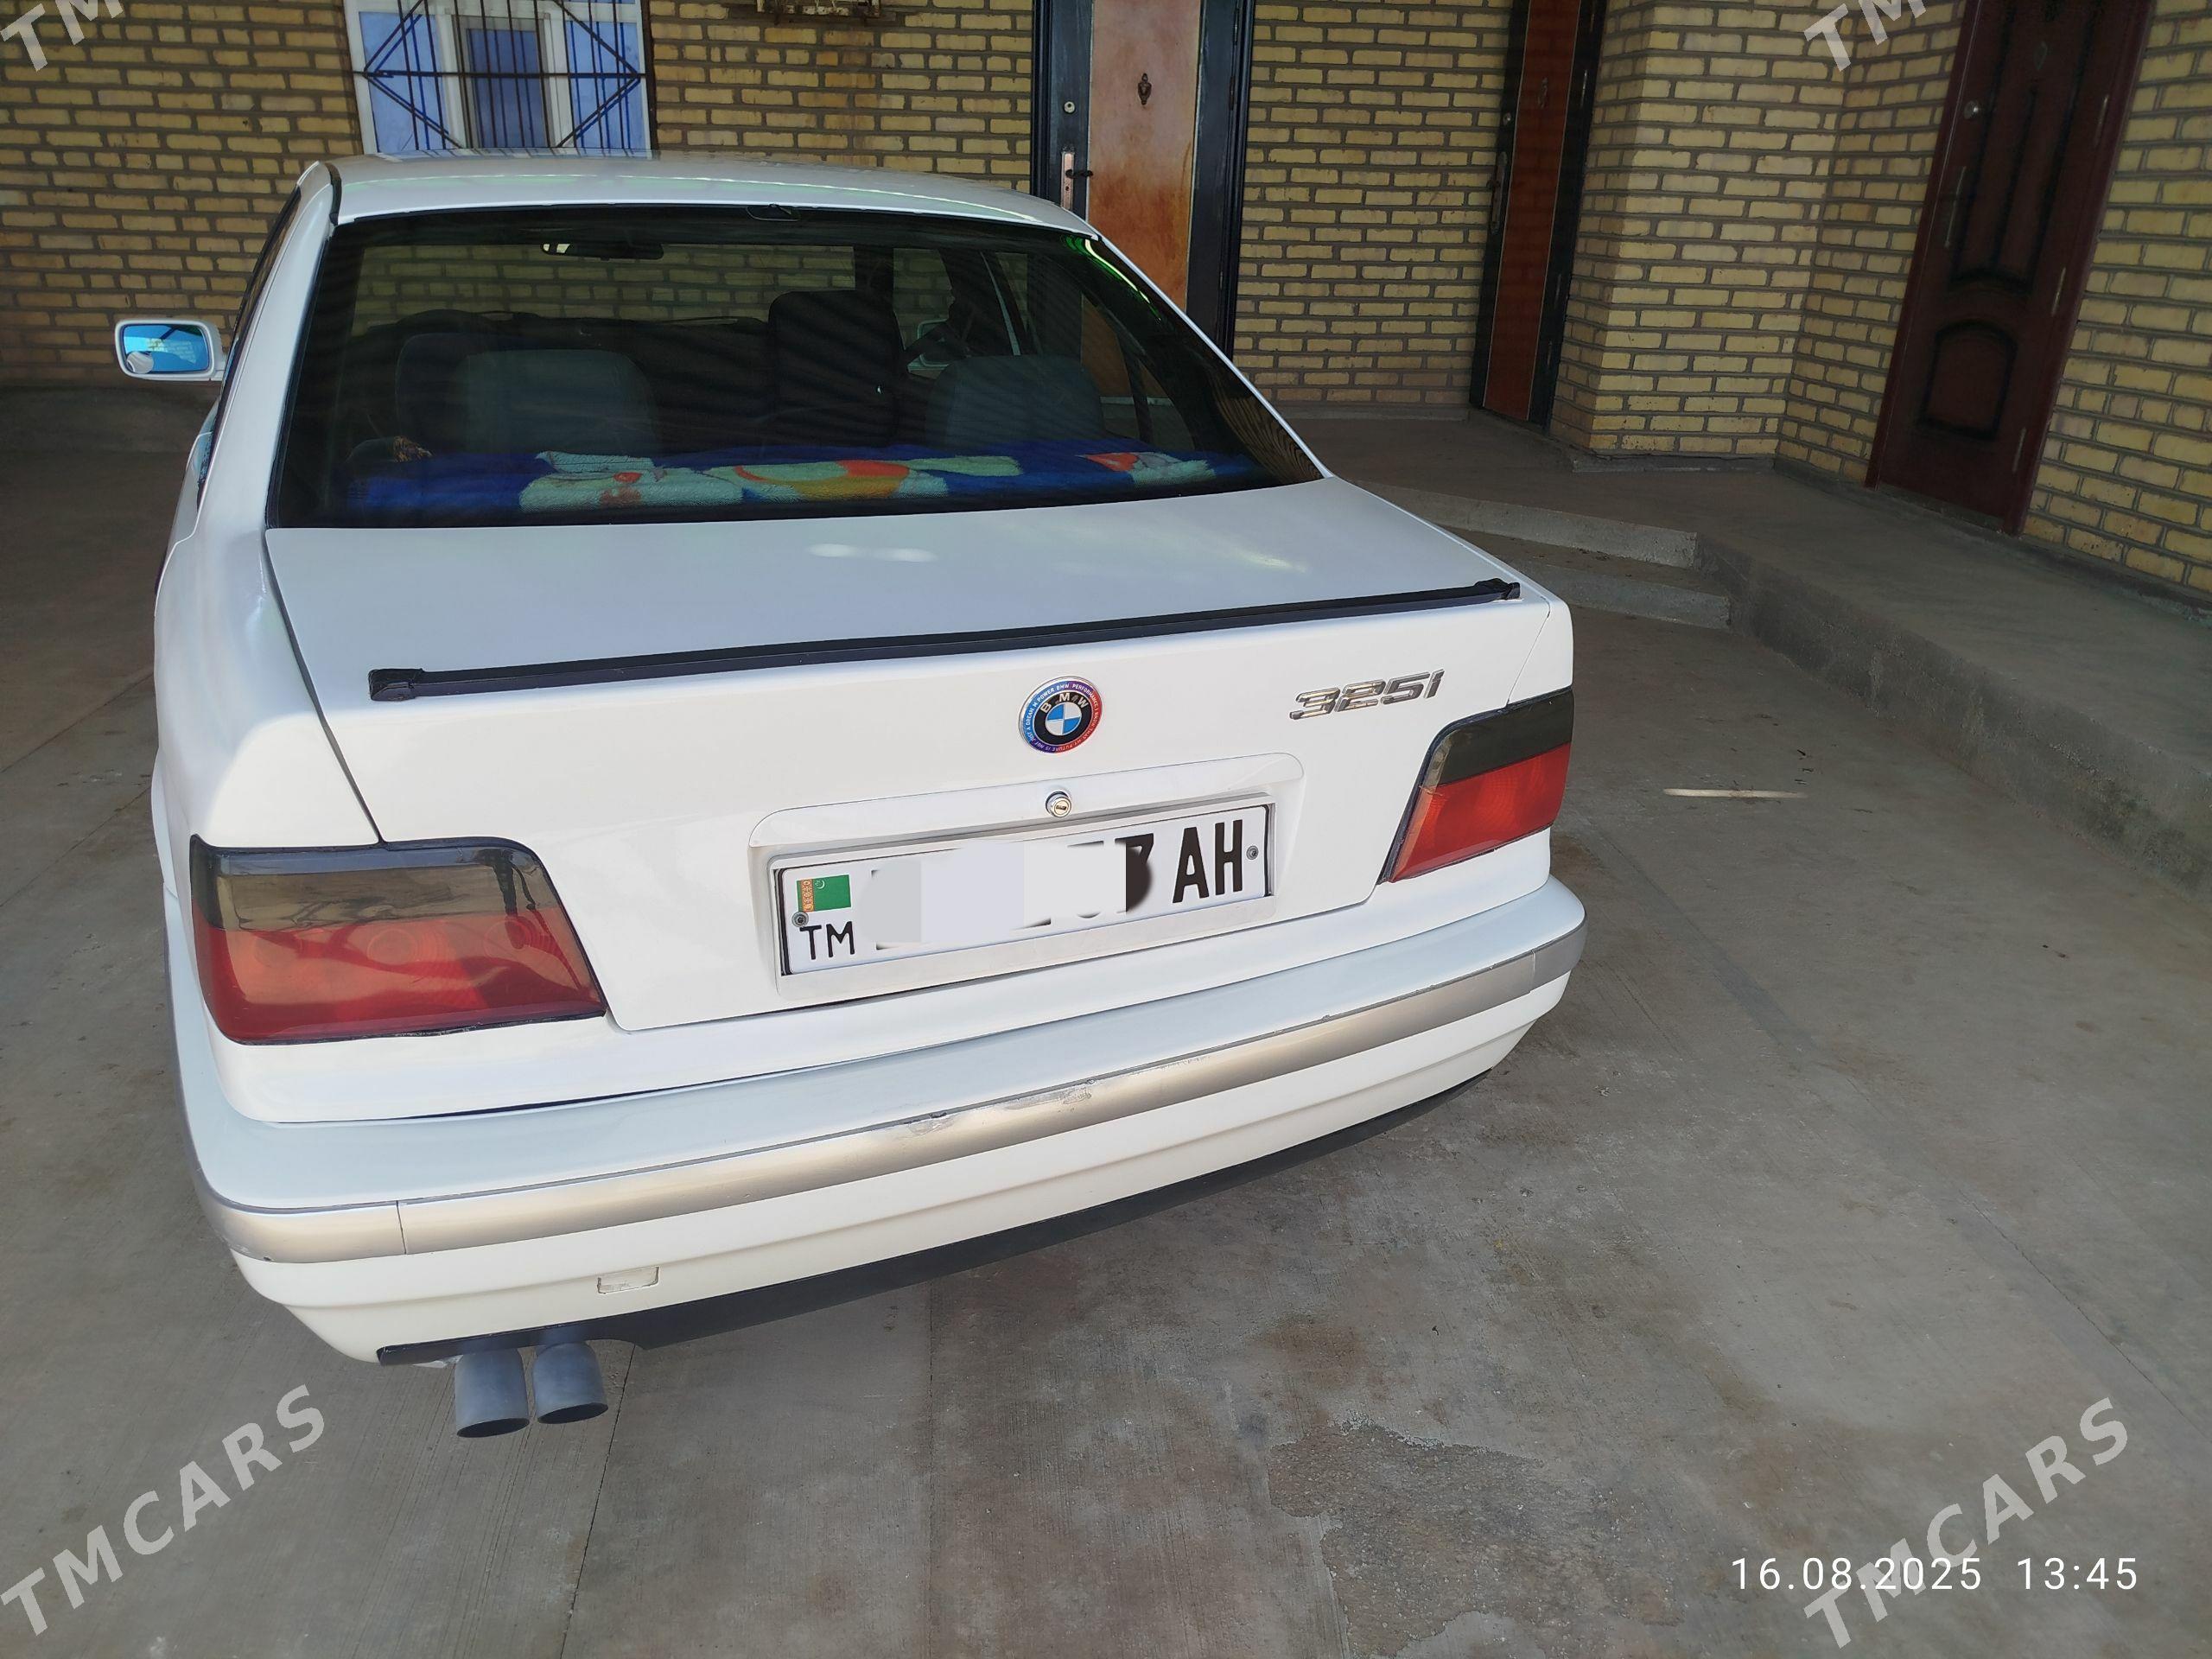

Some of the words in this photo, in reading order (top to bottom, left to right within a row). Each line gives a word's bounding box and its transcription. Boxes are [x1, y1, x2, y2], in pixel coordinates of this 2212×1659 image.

[1037, 688, 1055, 702] POWER
[1040, 692, 1089, 714] BMW
[1173, 819, 1243, 904] AH
[799, 921, 855, 960] TM
